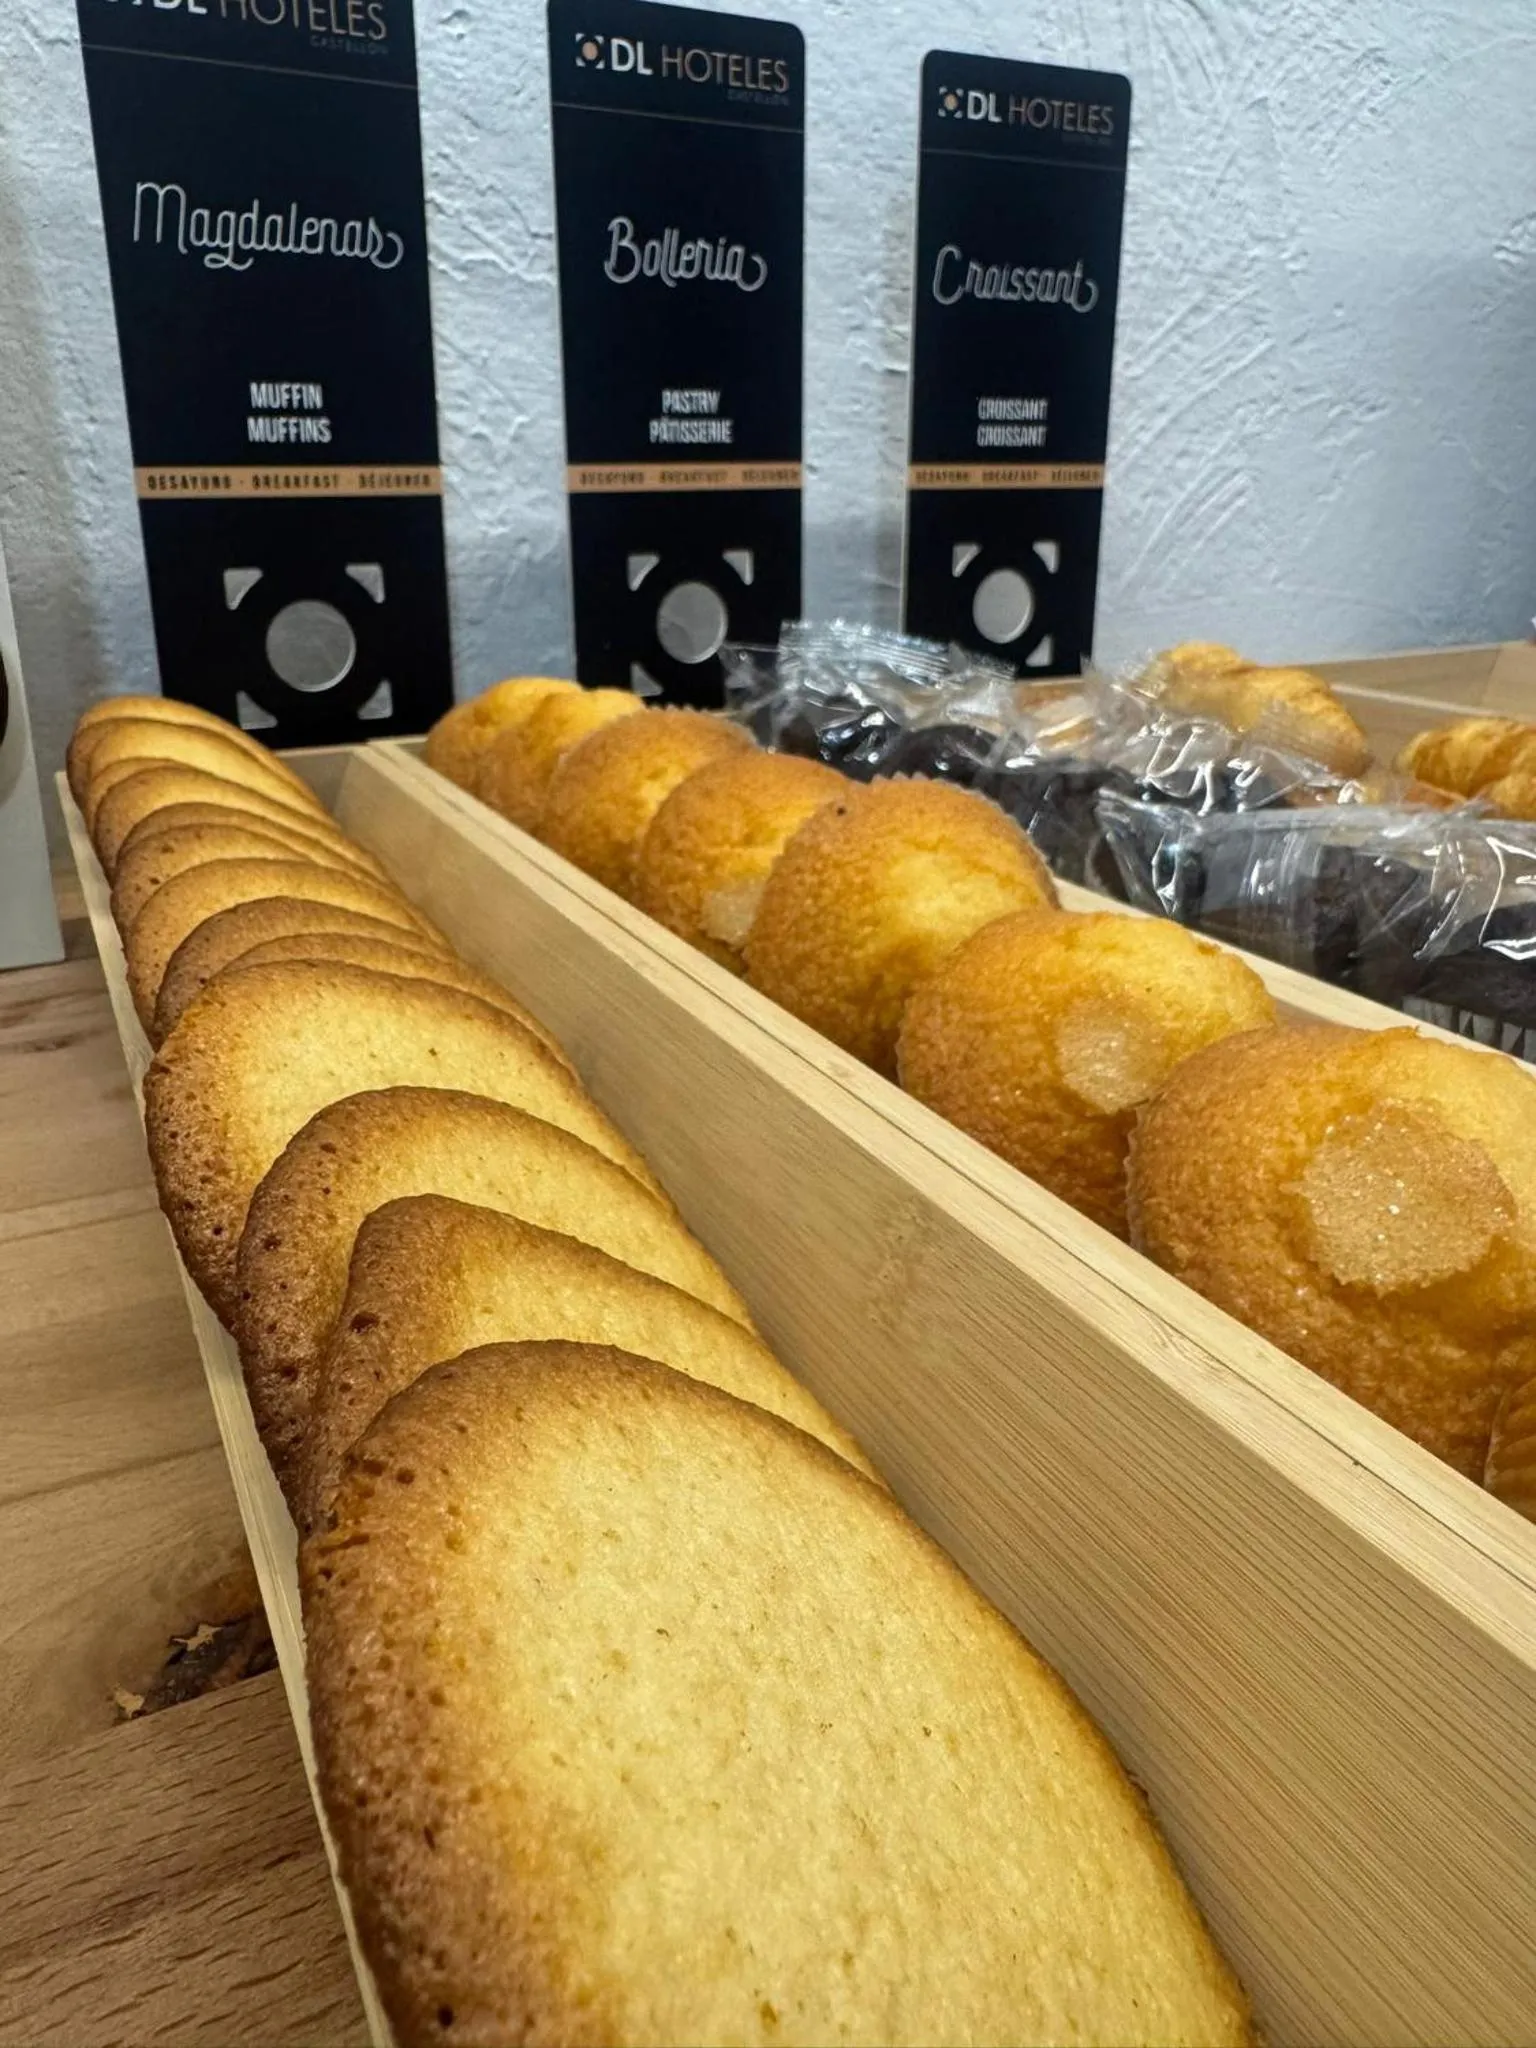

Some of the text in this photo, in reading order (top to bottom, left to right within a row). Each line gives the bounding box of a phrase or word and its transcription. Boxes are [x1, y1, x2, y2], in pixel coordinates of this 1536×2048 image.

[610, 37, 789, 93] DL HOTELES
[967, 90, 1114, 135] DL HOTELES
[133, 181, 404, 270] Magdalenas
[933, 244, 1099, 313] Croissant
[250, 382, 323, 409] MUFFIN
[661, 388, 721, 414] PASTRY
[247, 416, 332, 443] MUFFINS
